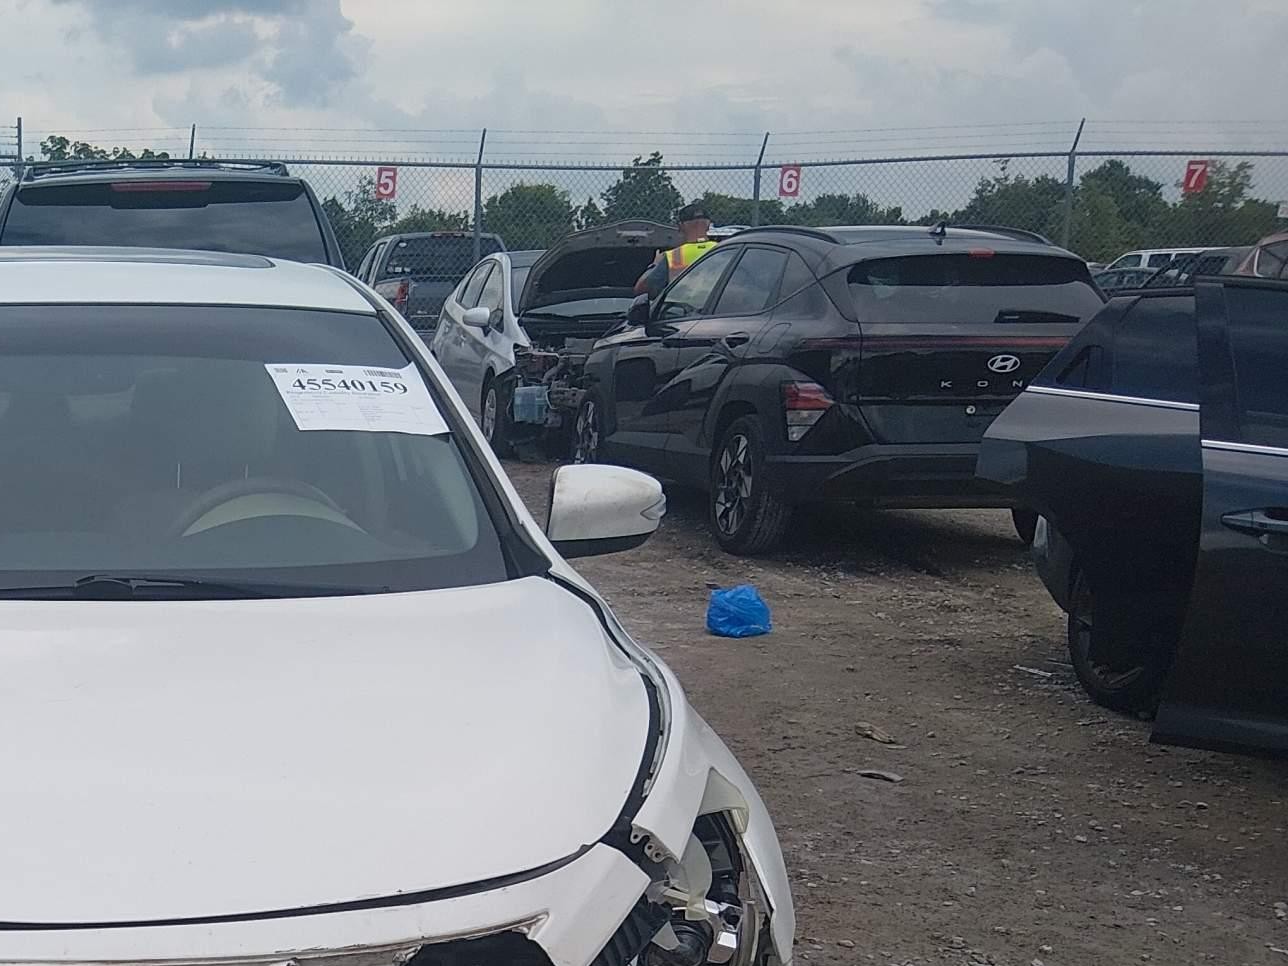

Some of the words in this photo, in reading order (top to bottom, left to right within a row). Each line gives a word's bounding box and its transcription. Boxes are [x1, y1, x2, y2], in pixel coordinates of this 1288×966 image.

[379, 171, 394, 195] 5
[782, 169, 798, 193] 6
[1189, 164, 1206, 188] 7
[292, 377, 408, 395] 45540159
[941, 380, 1023, 388] KON
